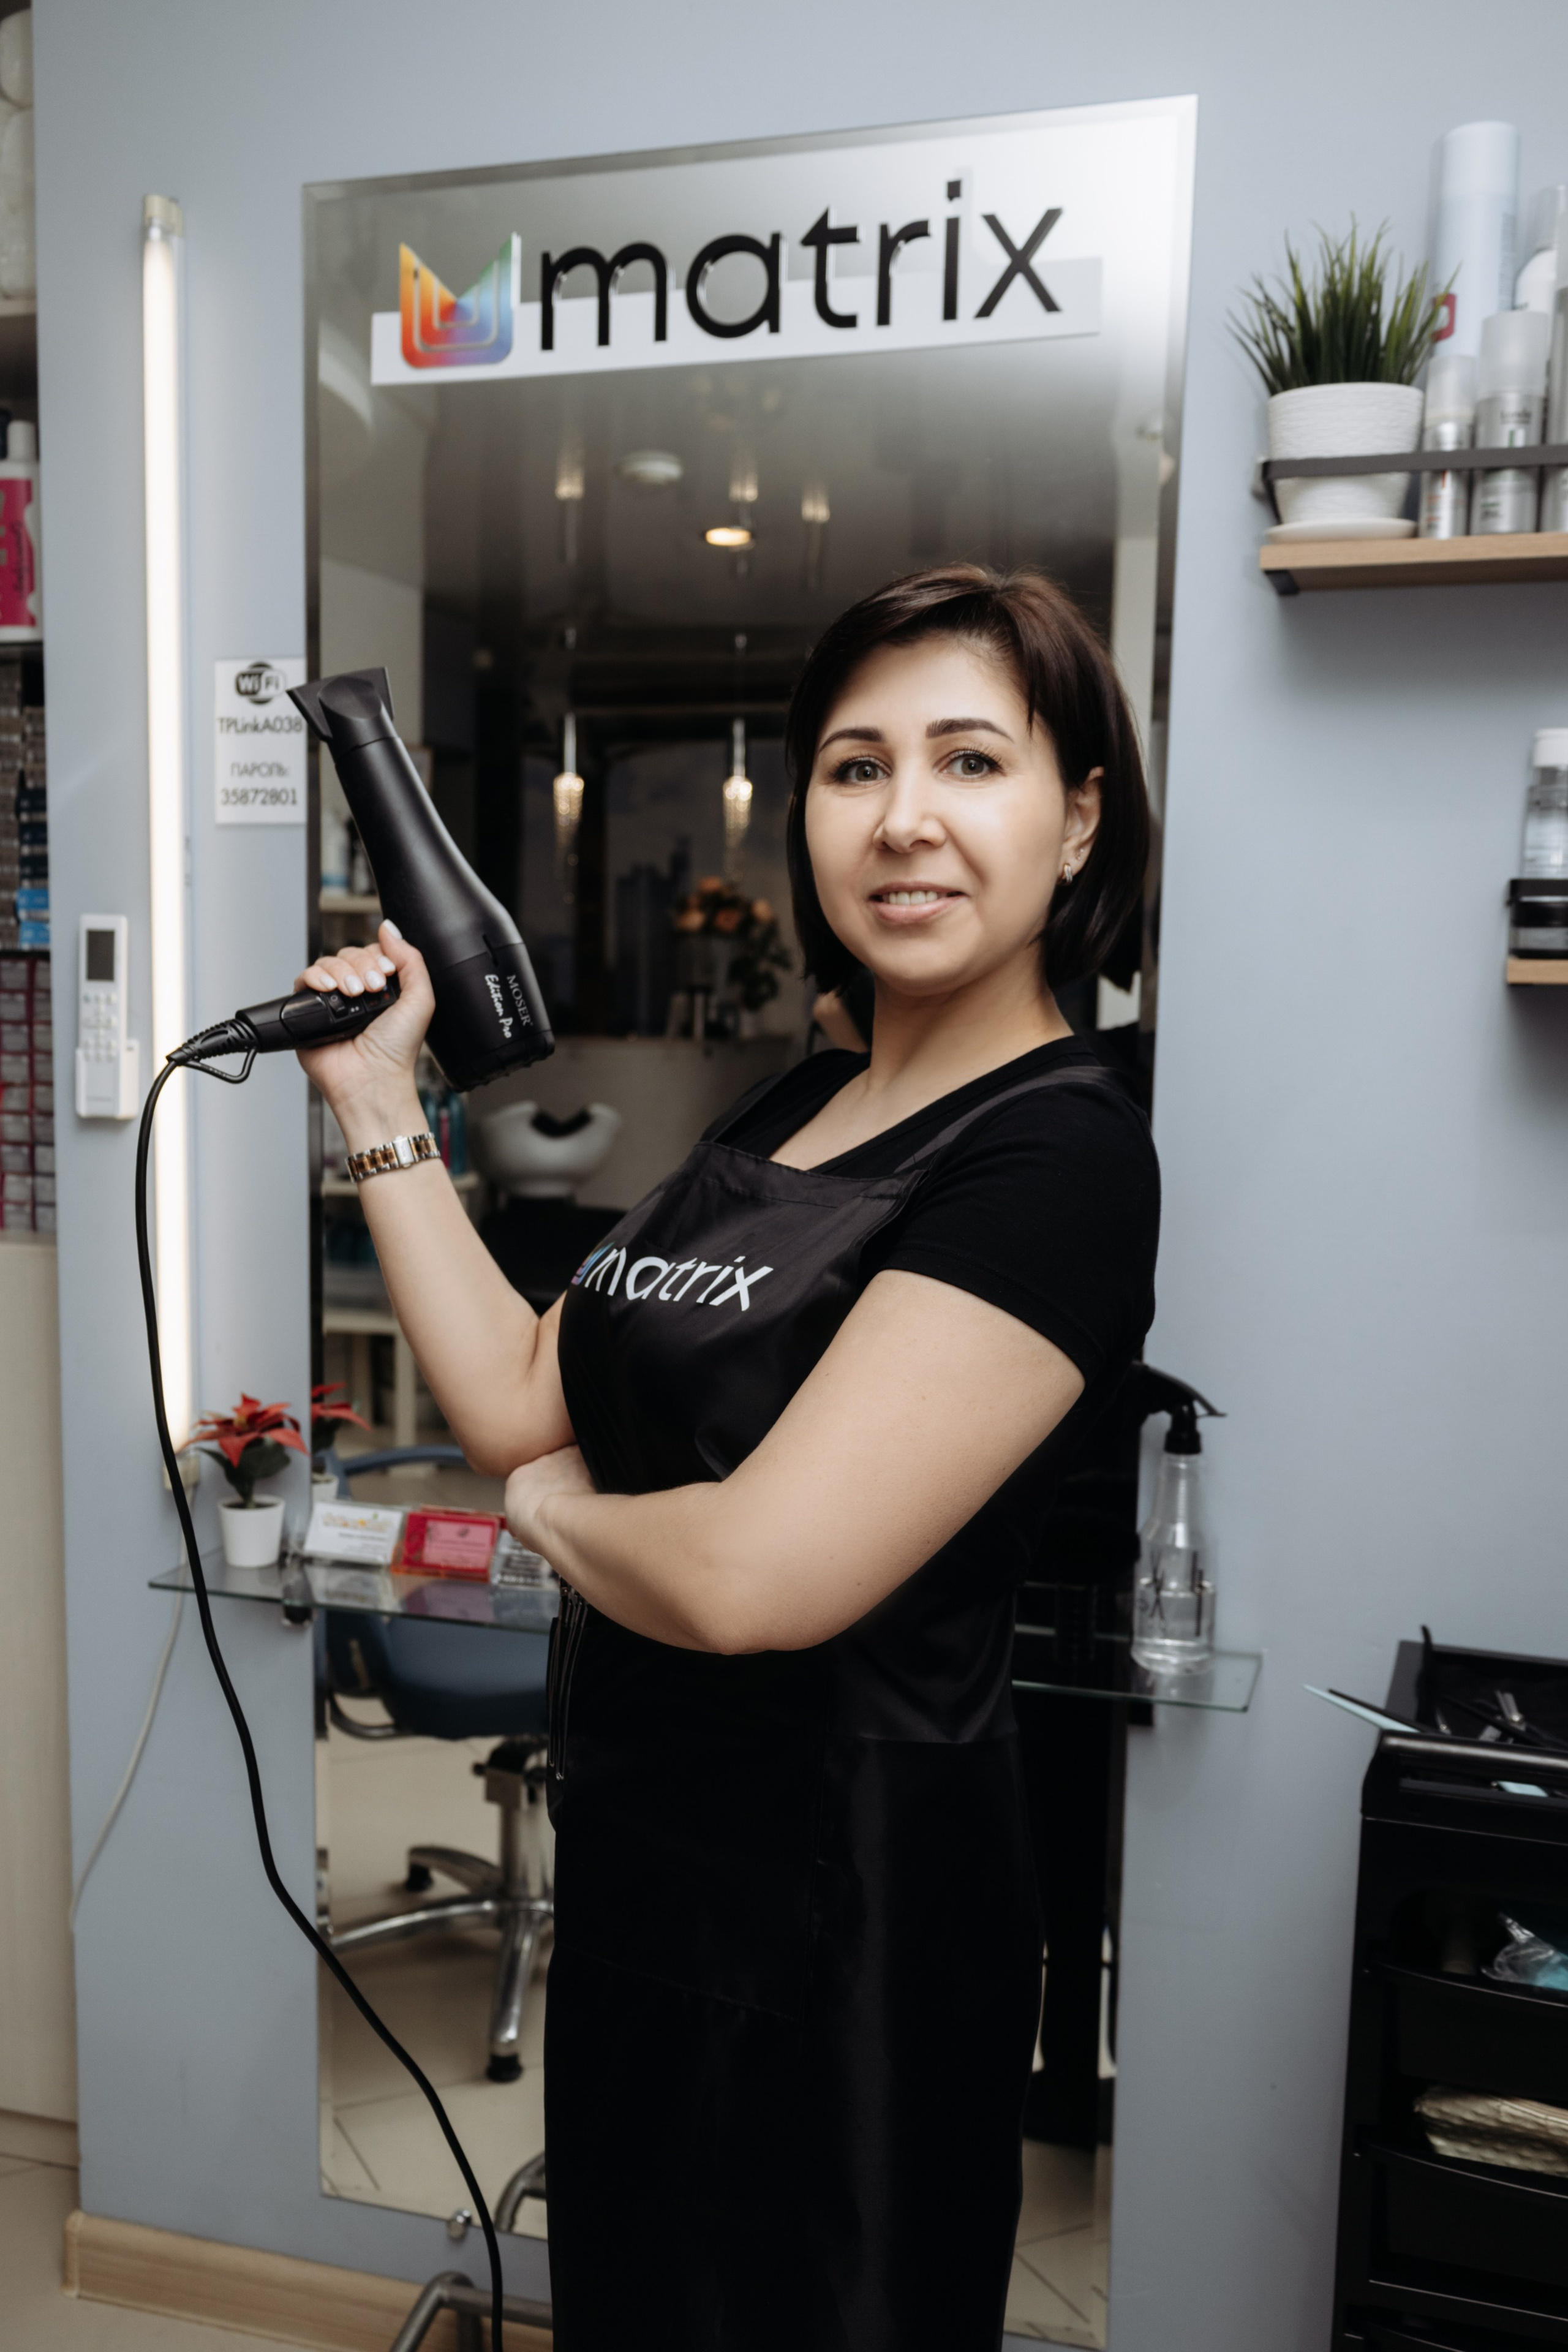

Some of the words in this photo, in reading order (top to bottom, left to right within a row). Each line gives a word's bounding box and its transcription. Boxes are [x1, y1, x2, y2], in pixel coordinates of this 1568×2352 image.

[540, 179, 1063, 351] matrix
[484, 974, 503, 1016] Edition
[499, 1017, 513, 1038] Pro
[507, 974, 531, 1026] MOSER
[584, 1246, 774, 1311] matrix
